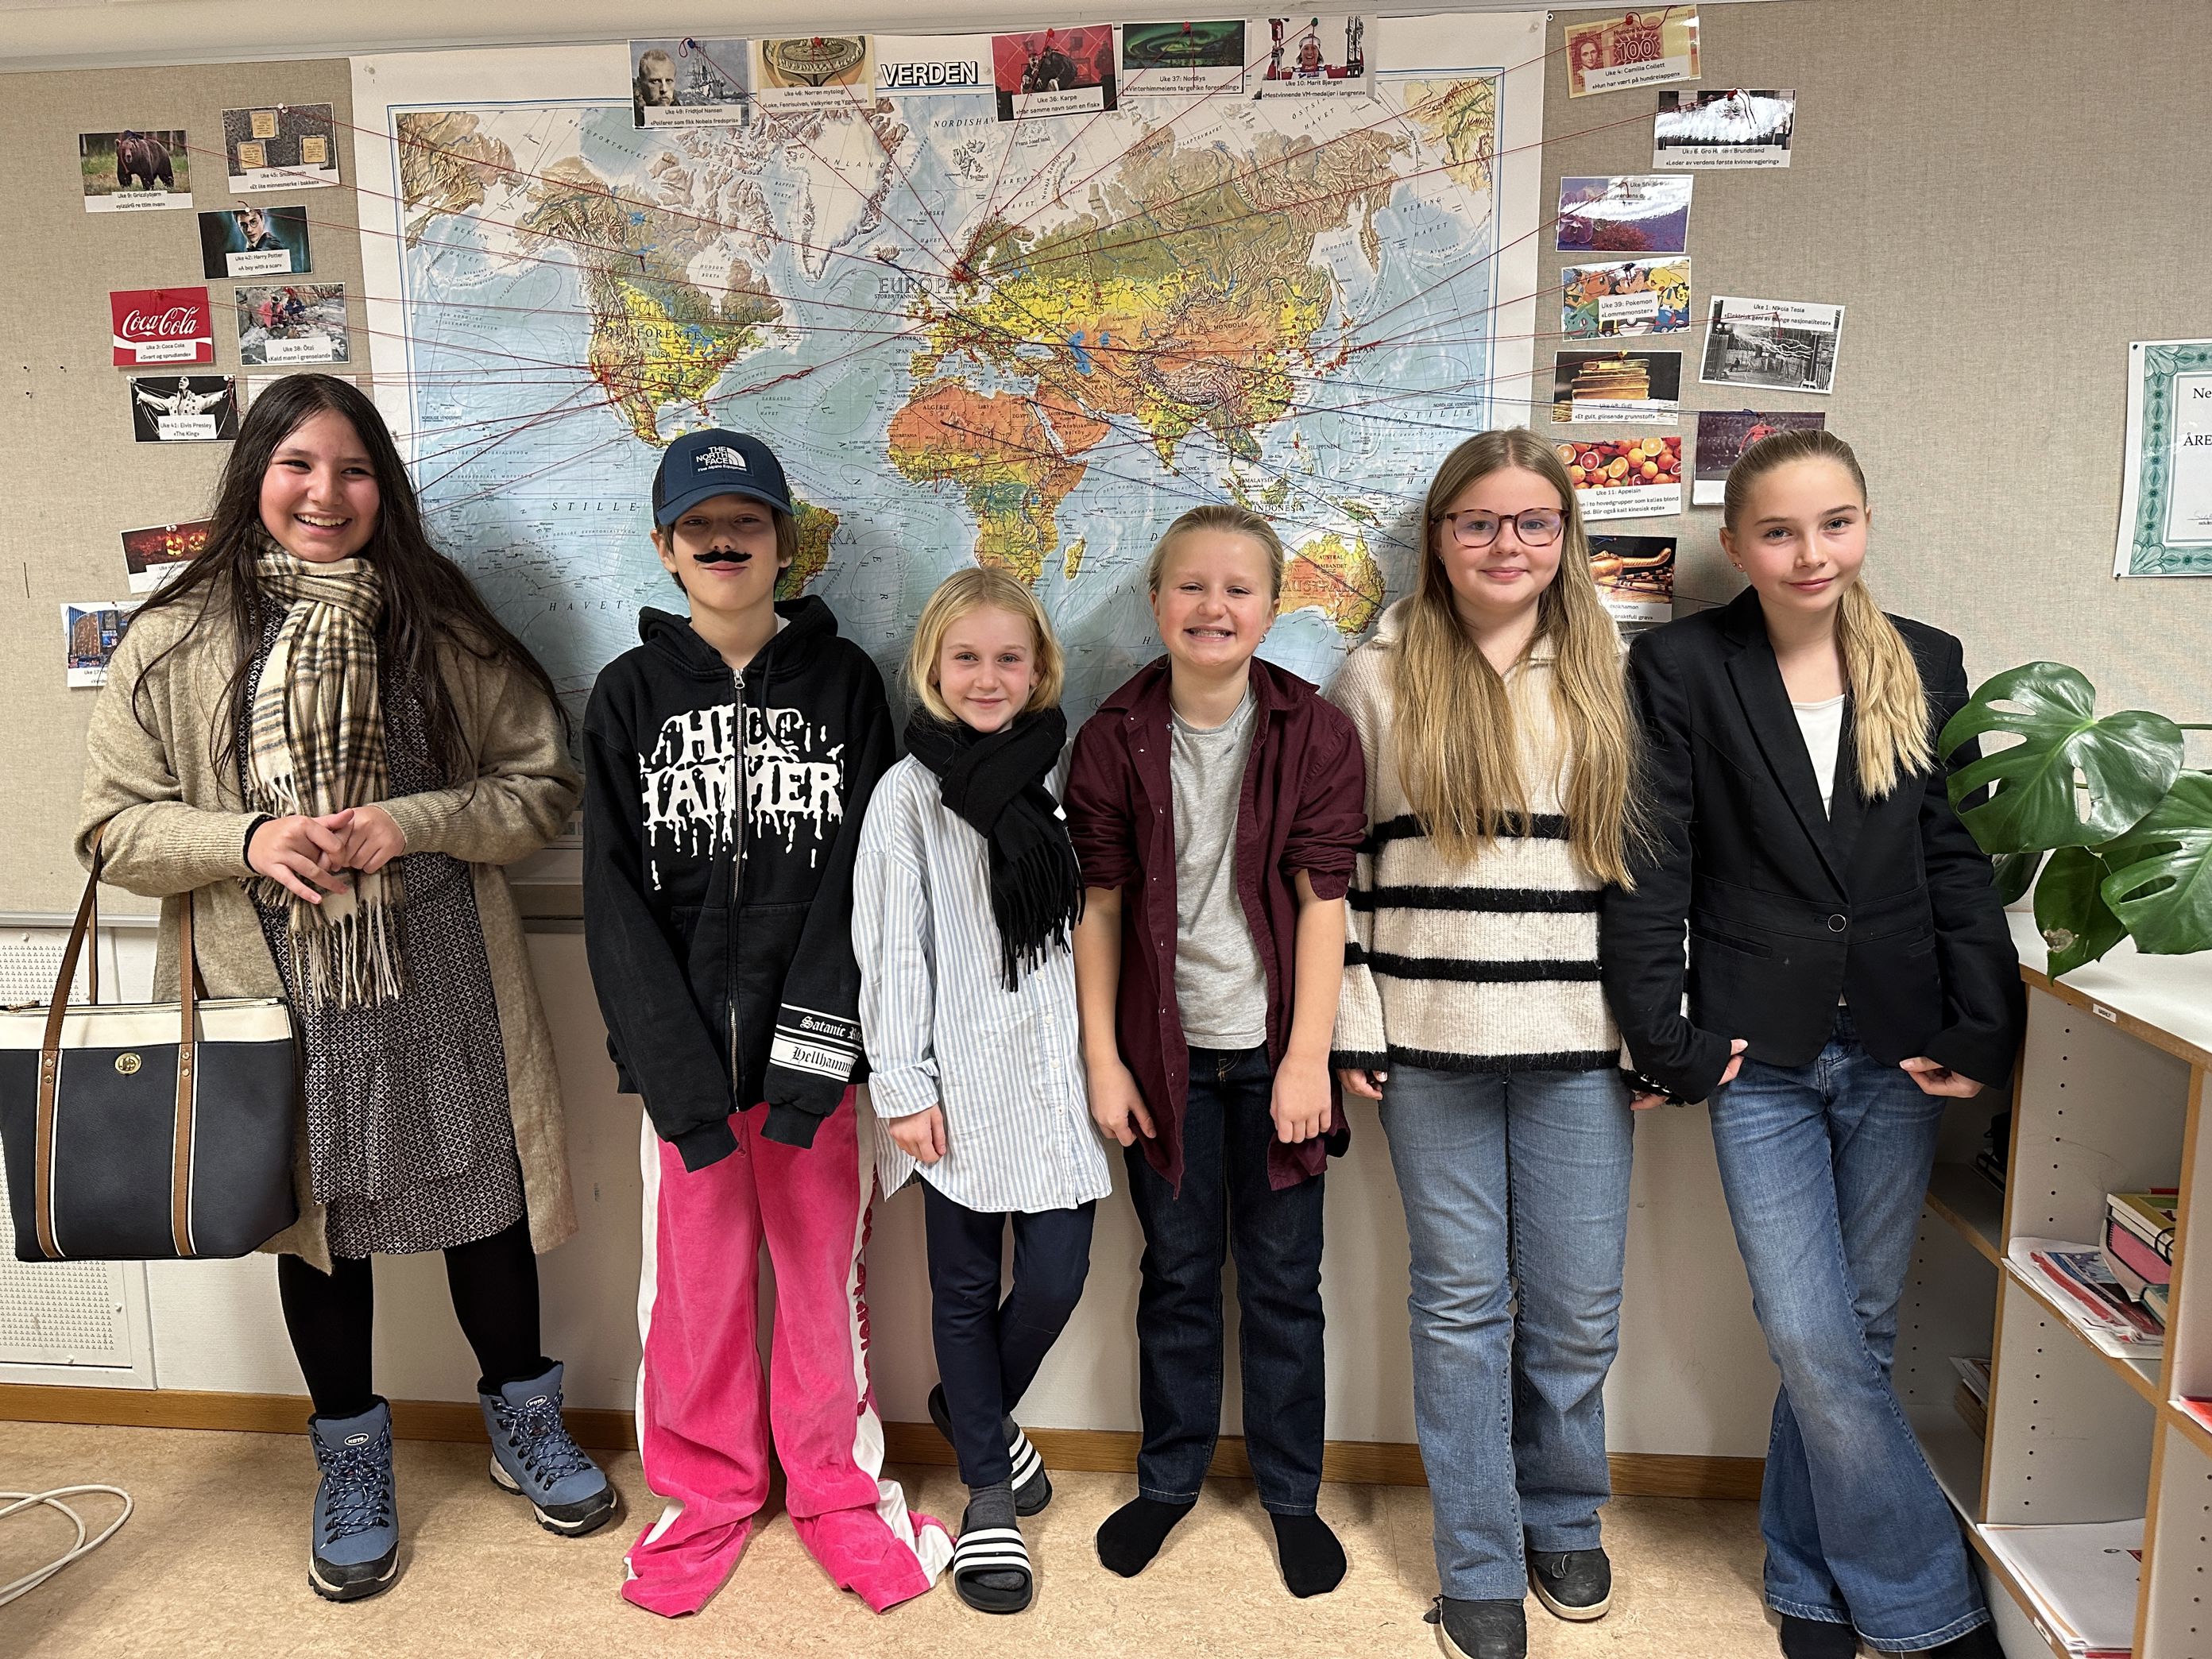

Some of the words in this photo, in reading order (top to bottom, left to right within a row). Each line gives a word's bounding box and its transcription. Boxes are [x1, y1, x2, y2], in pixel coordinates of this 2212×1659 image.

[1618, 38, 1654, 61] 100
[881, 60, 978, 87] VERDEN
[879, 277, 958, 294] EUROPA
[649, 288, 711, 299] CANADA
[624, 300, 766, 324] NORDAMERIKA
[122, 307, 200, 338] Coca-Cola
[1213, 322, 1248, 331] MONGOLIA
[637, 328, 702, 340] FORENTE
[652, 350, 673, 359] (USA)
[940, 431, 1030, 449] AFRIKA
[696, 451, 728, 462] NORTH
[1282, 581, 1366, 592] AUSTRALIA
[549, 600, 622, 612] HAVET
[799, 1016, 845, 1038] Satanic
